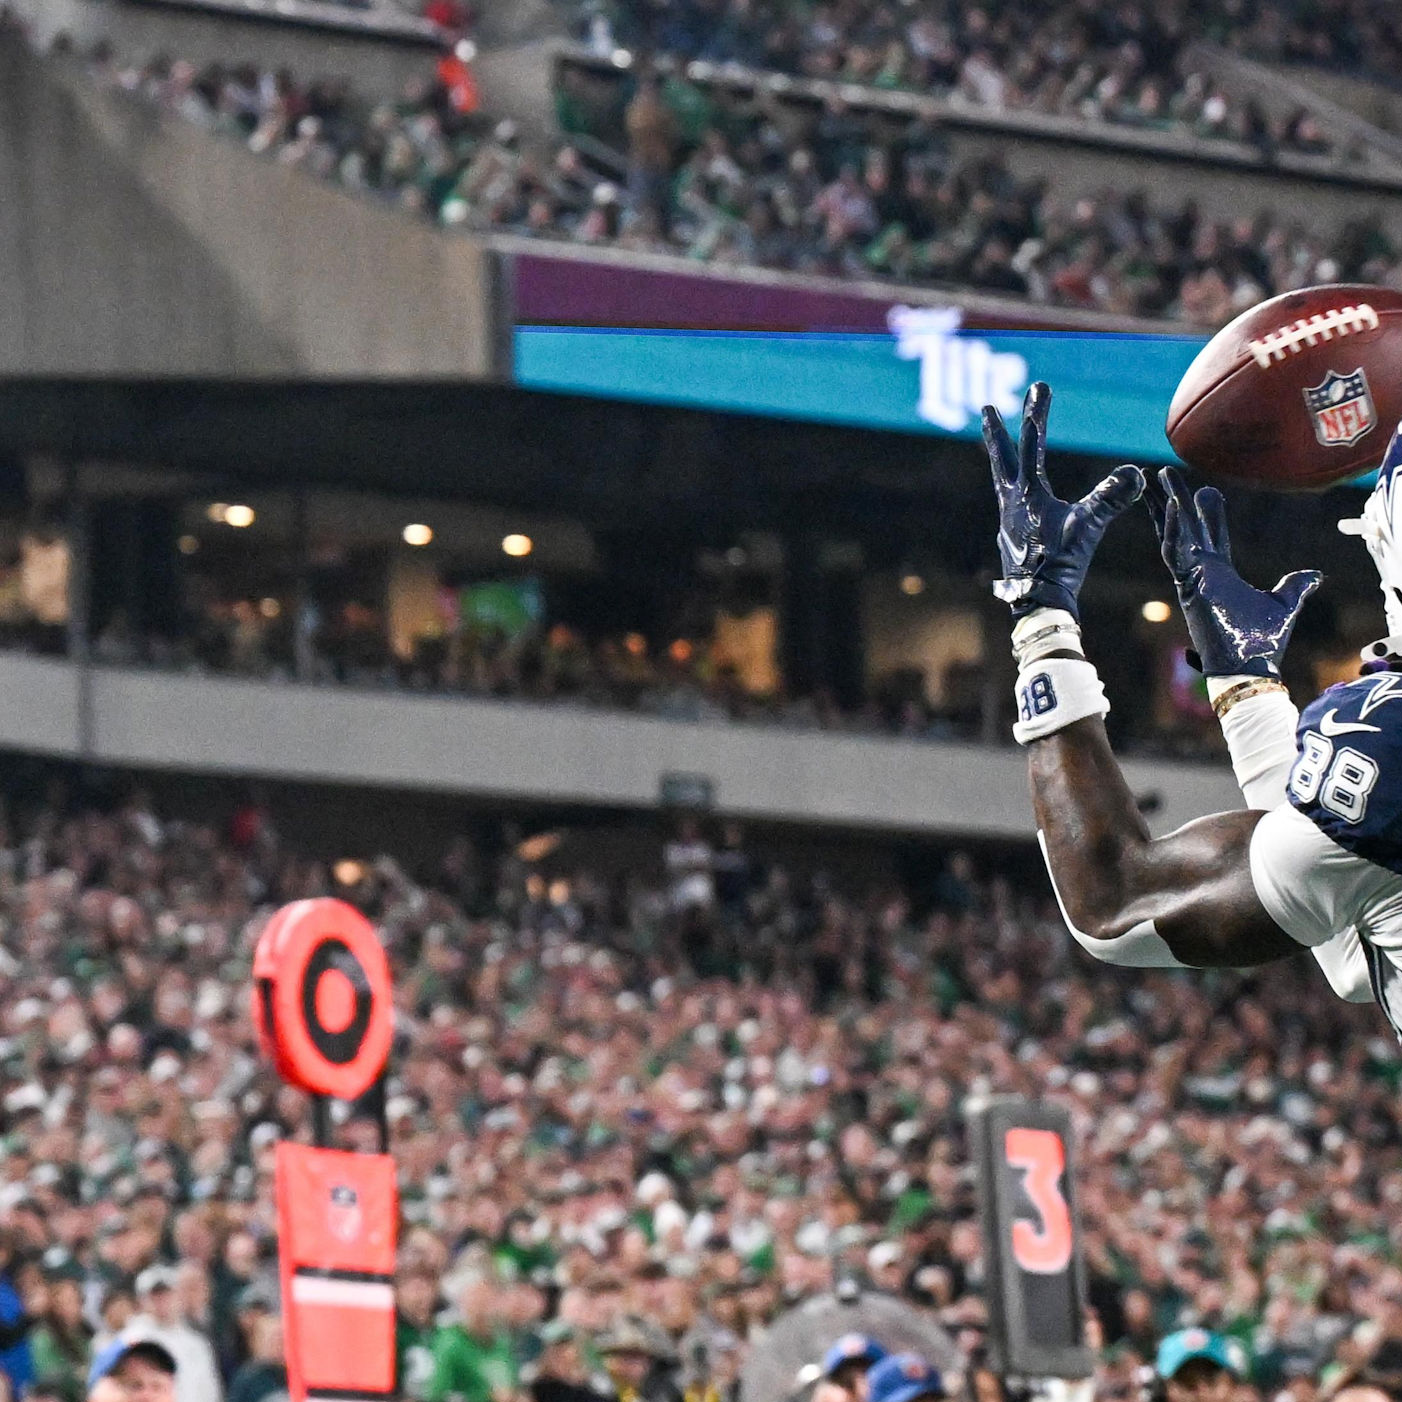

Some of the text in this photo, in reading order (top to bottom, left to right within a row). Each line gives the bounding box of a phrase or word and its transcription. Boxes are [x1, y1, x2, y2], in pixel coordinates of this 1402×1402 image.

[1317, 400, 1370, 438] NFL
[1289, 729, 1380, 825] 88
[1005, 1127, 1072, 1275] 3
